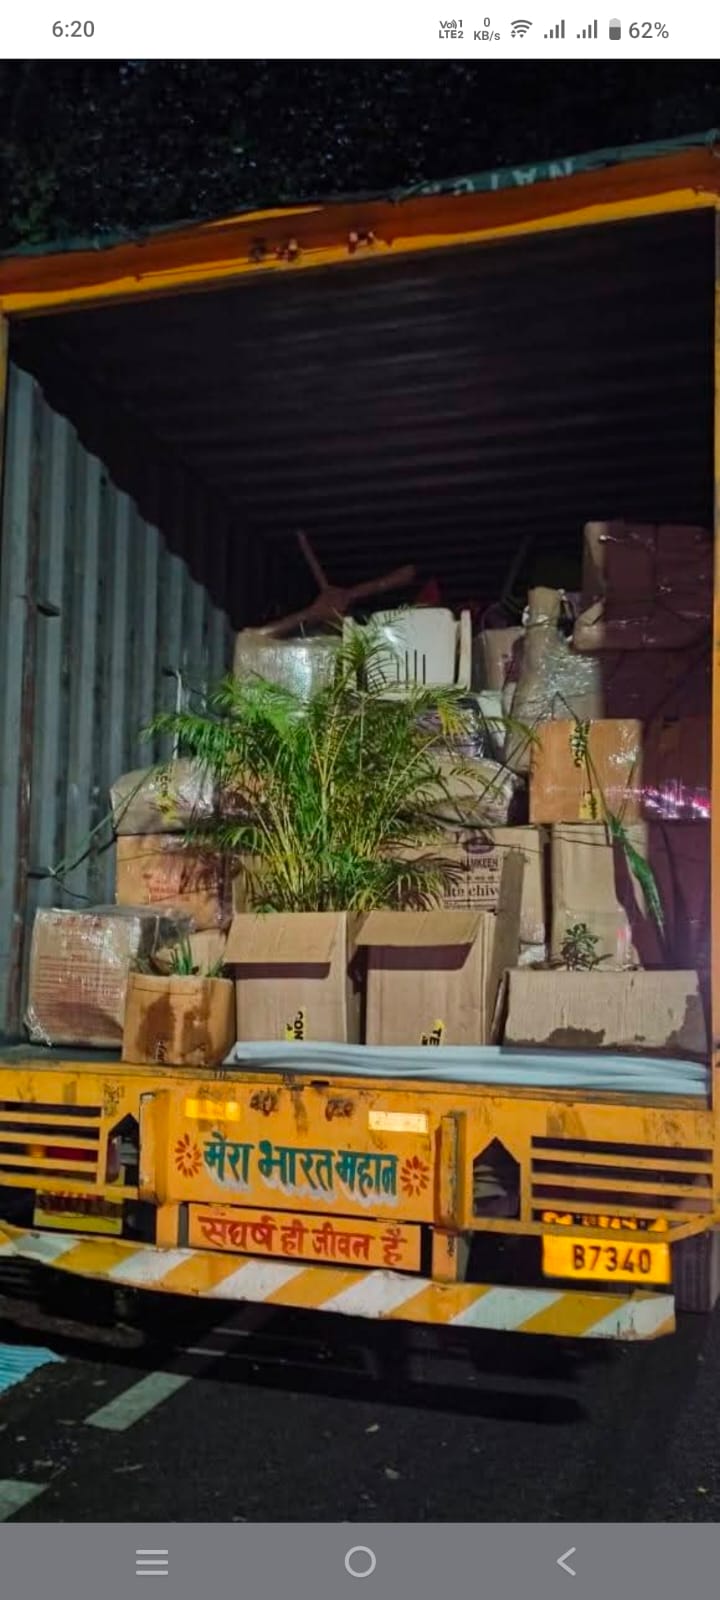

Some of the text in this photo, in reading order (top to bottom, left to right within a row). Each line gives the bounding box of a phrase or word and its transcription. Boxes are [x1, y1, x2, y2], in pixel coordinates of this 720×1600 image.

[203, 1131, 255, 1185] मेरा
[258, 1140, 336, 1192] भारत
[280, 1219, 309, 1255] ही
[311, 1222, 376, 1261] जीवन
[380, 1227, 408, 1266] है
[573, 1244, 652, 1274] B7340
